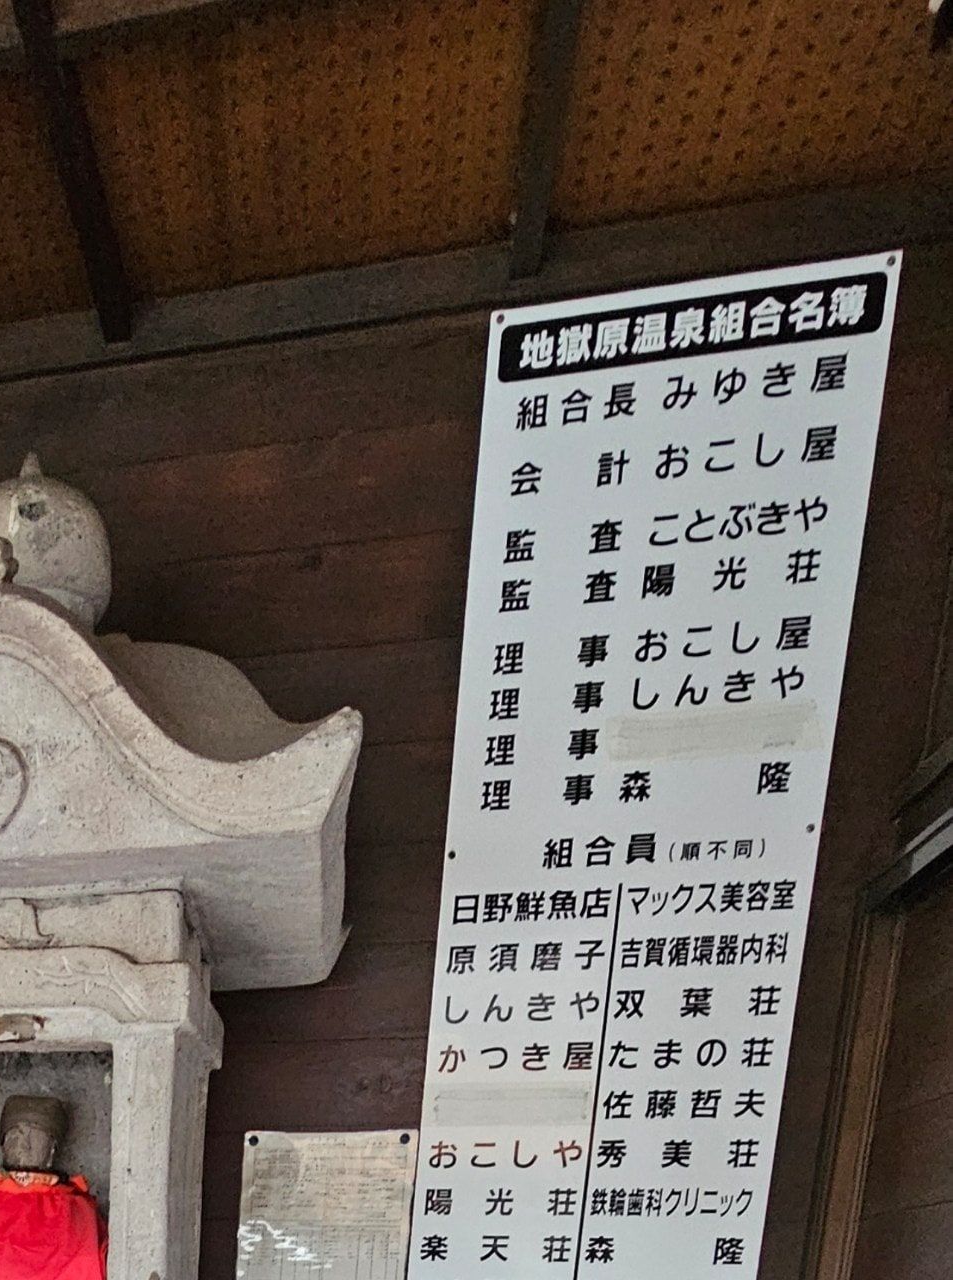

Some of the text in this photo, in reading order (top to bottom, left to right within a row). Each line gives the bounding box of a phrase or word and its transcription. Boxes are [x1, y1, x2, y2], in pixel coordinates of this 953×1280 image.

[519, 283, 870, 372] 地獄原温泉組合名簿
[516, 353, 848, 431] 組合長 みゆき屋
[511, 425, 837, 496] 会計 おこし屋
[503, 496, 828, 564] 監査 ことぶきや
[499, 548, 821, 613] 監査 陽光荘
[493, 615, 811, 675] 理事 おこし屋
[489, 665, 804, 720] 理事 しんきや
[485, 729, 599, 766] 理事
[481, 774, 595, 811] 理事
[542, 833, 656, 869] 組合員
[453, 887, 612, 925] 日野鮮魚店
[628, 879, 796, 916] マックス美容室
[446, 940, 605, 974] 原須磨子
[621, 932, 788, 969] 吉賀循環器内科
[446, 991, 599, 1024] しんきや
[614, 985, 781, 1019] 双葉荘
[438, 1042, 593, 1073] かつき屋
[609, 1037, 774, 1069] たまの荘
[603, 1089, 765, 1119] 佐藤哲夫
[429, 1140, 582, 1169] おこしや
[597, 1139, 759, 1168] 秀美荘
[424, 1188, 577, 1216] 陽光荘
[590, 1188, 753, 1217] 鉄輪歯科クリニック
[420, 1235, 571, 1262] 楽天荘
